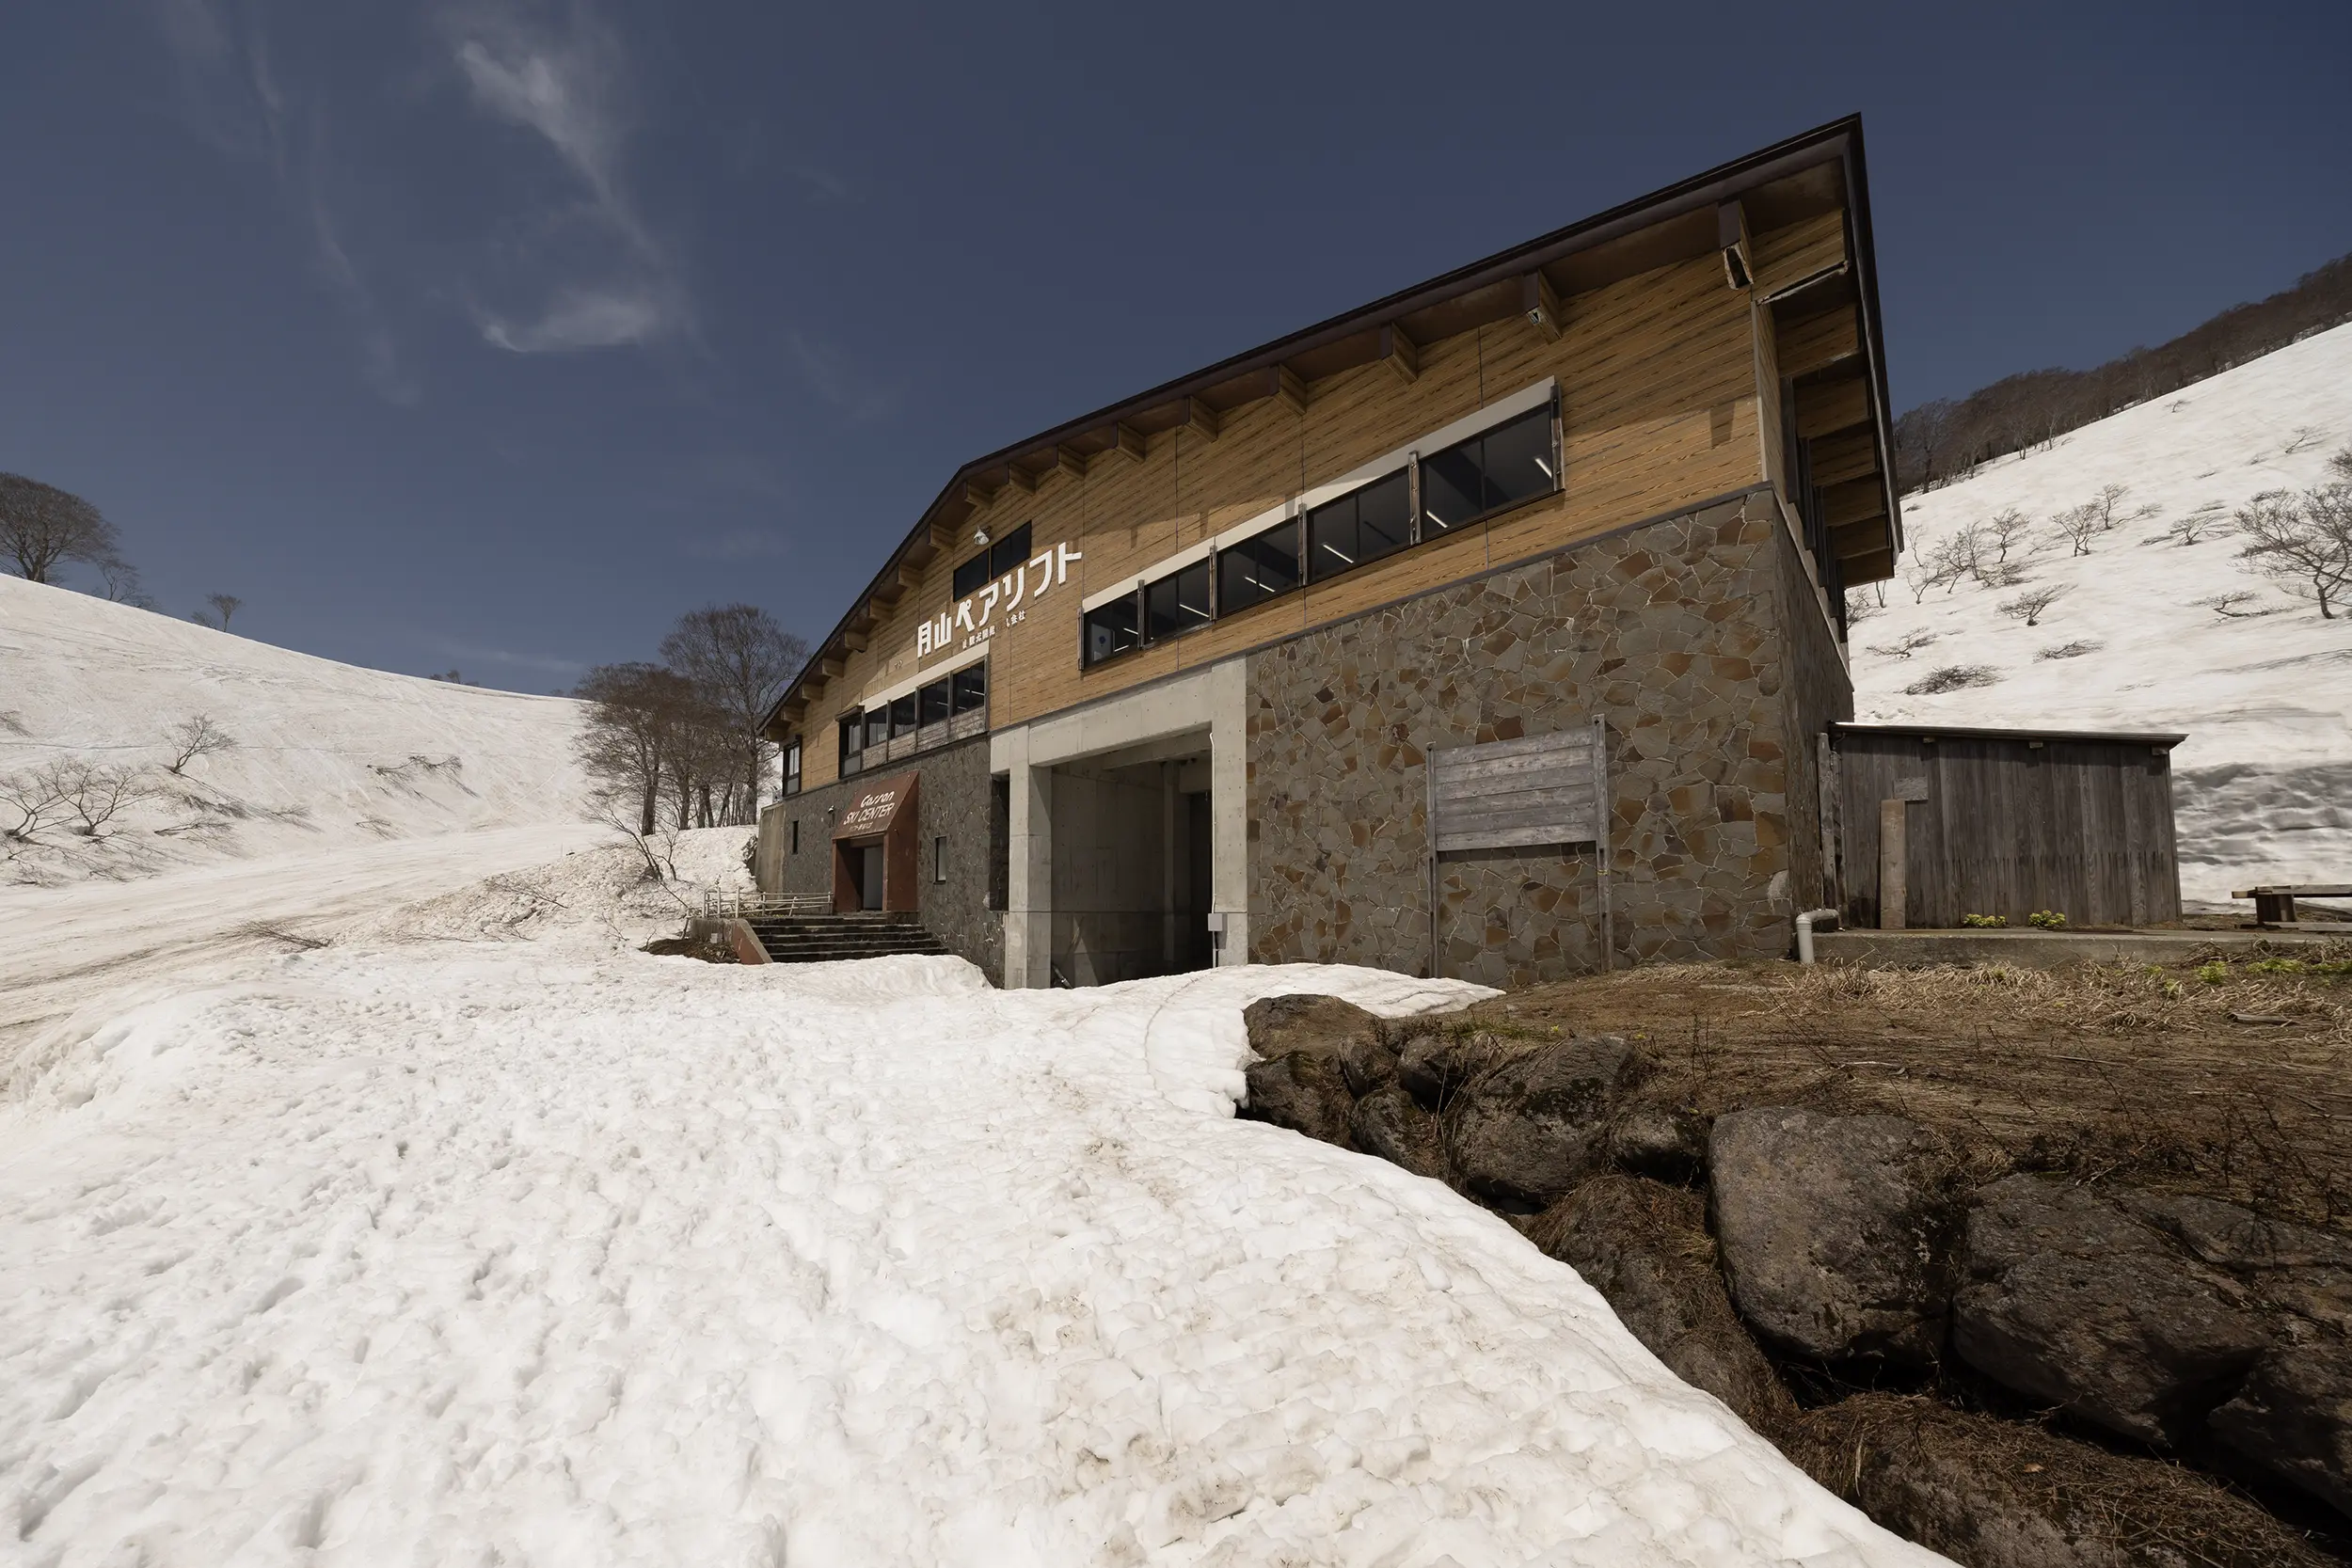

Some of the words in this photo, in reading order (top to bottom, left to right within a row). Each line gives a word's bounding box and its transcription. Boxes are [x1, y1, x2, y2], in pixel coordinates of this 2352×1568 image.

[917, 541, 1082, 658] 月山ペアリフト
[843, 811, 860, 825] SKI
[857, 802, 895, 822] CENTER
